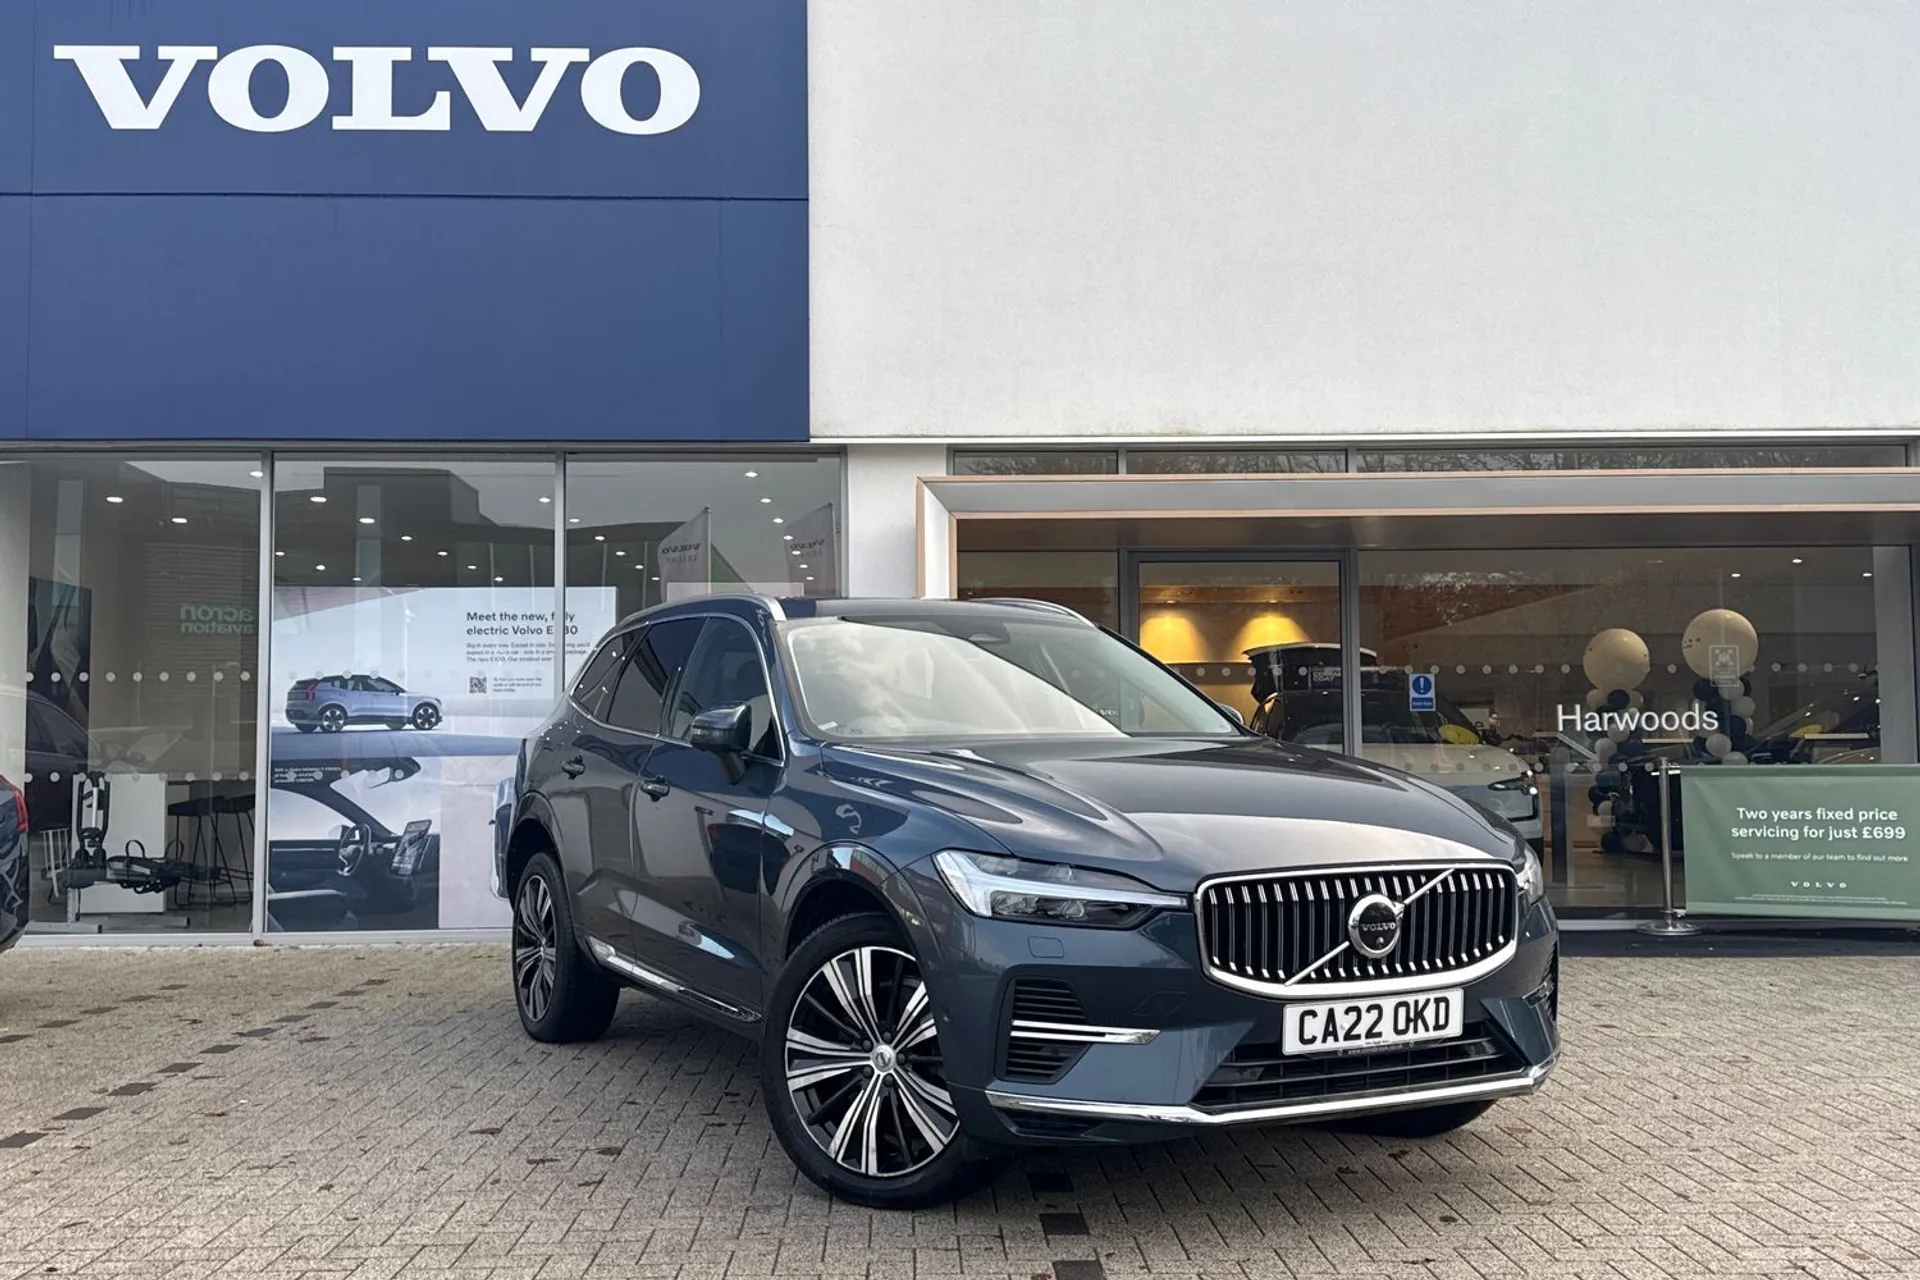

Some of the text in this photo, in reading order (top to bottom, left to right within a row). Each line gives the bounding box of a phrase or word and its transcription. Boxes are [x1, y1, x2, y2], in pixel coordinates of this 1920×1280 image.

[54, 45, 700, 134] VOLVO
[466, 611, 575, 623] Meet the new, fly
[466, 625, 578, 635] electric Volvo E30
[1556, 702, 1719, 732] Harwoods
[1736, 807, 1898, 823] Two years fixed price
[1731, 826, 1906, 841] servicing for just £699
[1731, 852, 1754, 861] Speak
[1755, 852, 1763, 860] to
[1771, 852, 1802, 861] member
[1803, 852, 1811, 860] of
[1826, 853, 1846, 861] team
[1857, 853, 1872, 862] find
[1361, 922, 1396, 931] VOLVO
[1299, 996, 1450, 1046] CA22 OKD
